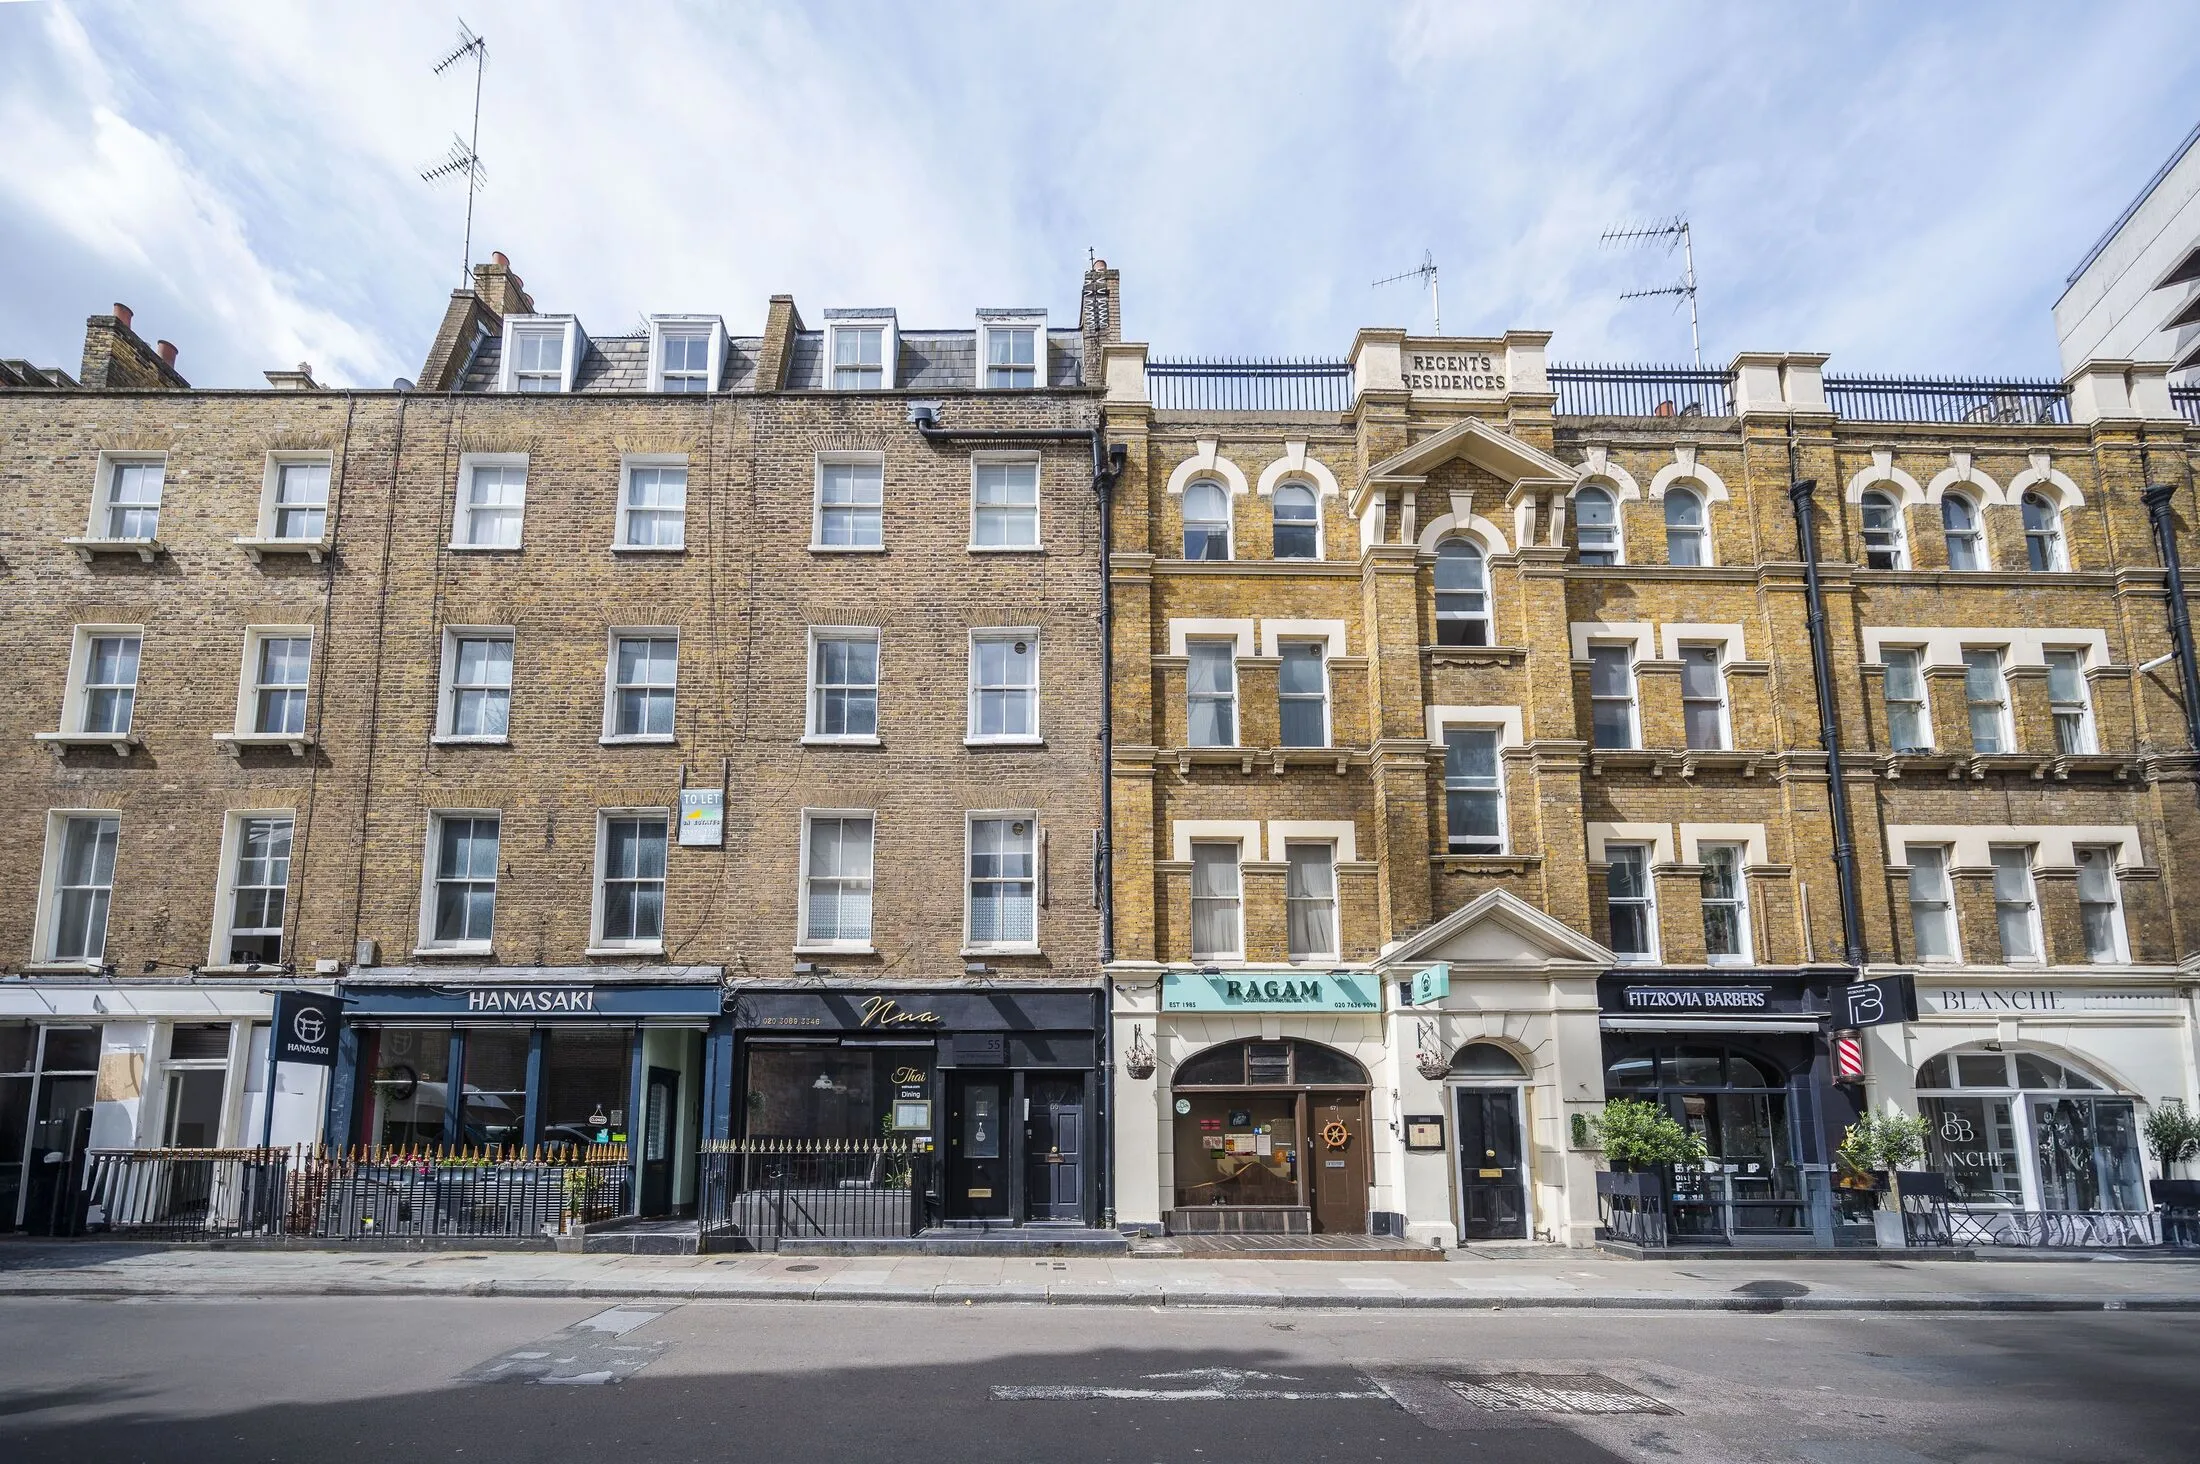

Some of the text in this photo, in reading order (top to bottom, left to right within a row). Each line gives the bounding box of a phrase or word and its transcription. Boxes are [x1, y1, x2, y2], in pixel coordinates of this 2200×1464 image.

[1401, 374, 1505, 389] RESIDENCES
[684, 793, 719, 804] TO LET
[1227, 980, 1319, 998] RAGAM
[469, 991, 593, 1010] HANASAKI
[1629, 992, 1765, 1006] FITZROVIA BARBERS
[1942, 990, 2065, 1010] BLANCHE
[860, 996, 940, 1027] Nua
[763, 1017, 776, 1025] 020
[287, 1043, 329, 1055] HANASAKI
[988, 1040, 1000, 1050] 55
[891, 1066, 926, 1084] Thai
[1923, 1151, 2006, 1167] LANCHE
